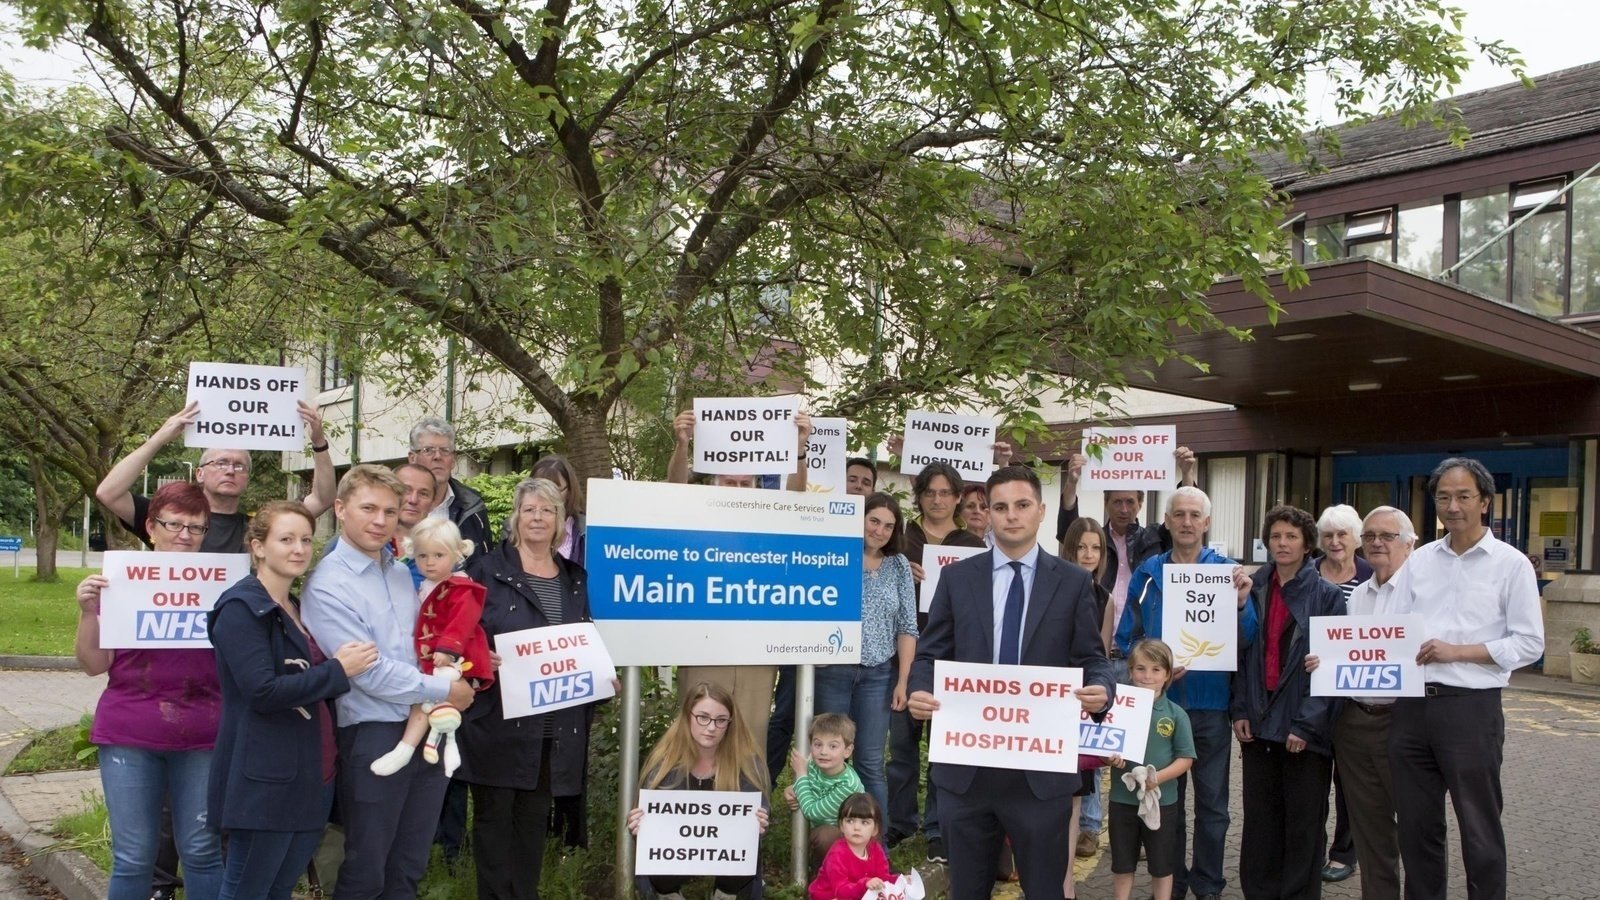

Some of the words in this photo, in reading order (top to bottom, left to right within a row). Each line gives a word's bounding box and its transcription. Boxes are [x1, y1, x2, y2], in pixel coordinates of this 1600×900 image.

[196, 376, 260, 390] HANDS
[267, 379, 298, 392] OFF
[228, 400, 268, 413] OUR
[702, 410, 757, 421] HANDS
[763, 410, 791, 420] OFF
[197, 421, 295, 437] HOSPITAL!
[912, 420, 959, 434] HANDS
[964, 426, 990, 437] OFF
[731, 431, 764, 441] OUR
[1142, 435, 1169, 444] OFF
[934, 440, 963, 452] OUR
[704, 451, 788, 462] HOSPITAL!
[1113, 452, 1144, 462] OUR
[1091, 470, 1167, 480] HOSPITAL!
[773, 502, 792, 511] Care
[793, 503, 825, 513] Services
[830, 503, 854, 514] NHS
[605, 545, 677, 560] Welcome
[684, 549, 699, 560] to
[705, 548, 787, 563] Cirencester
[793, 552, 848, 568] Hospital
[126, 566, 160, 581] WE
[168, 567, 226, 582] LOVE
[1172, 573, 1190, 583] Lib
[1196, 573, 1230, 583] Dems
[615, 575, 693, 602] Main
[708, 577, 837, 605] Entrance
[152, 592, 200, 606] OUR
[1186, 590, 1215, 606] Say
[1186, 610, 1214, 622] NO!
[1327, 628, 1353, 640] WE
[1358, 627, 1405, 640] LOVE
[515, 641, 543, 657] WE
[548, 635, 588, 651] LOVE
[766, 644, 834, 655] Understanding
[1348, 649, 1385, 661] OUR
[540, 659, 577, 675] OUR
[1338, 665, 1400, 689] NHS
[533, 673, 591, 705] NHS
[944, 678, 1021, 695] HANDS
[1029, 681, 1071, 697] OFF
[983, 707, 1029, 722] OUR
[1081, 710, 1113, 723] OR
[945, 732, 1064, 754] HOSPITAL!
[648, 803, 711, 815] HANDS
[718, 804, 752, 816] OFF
[680, 825, 718, 838] OUR
[649, 848, 745, 861] HOSPITAL!
